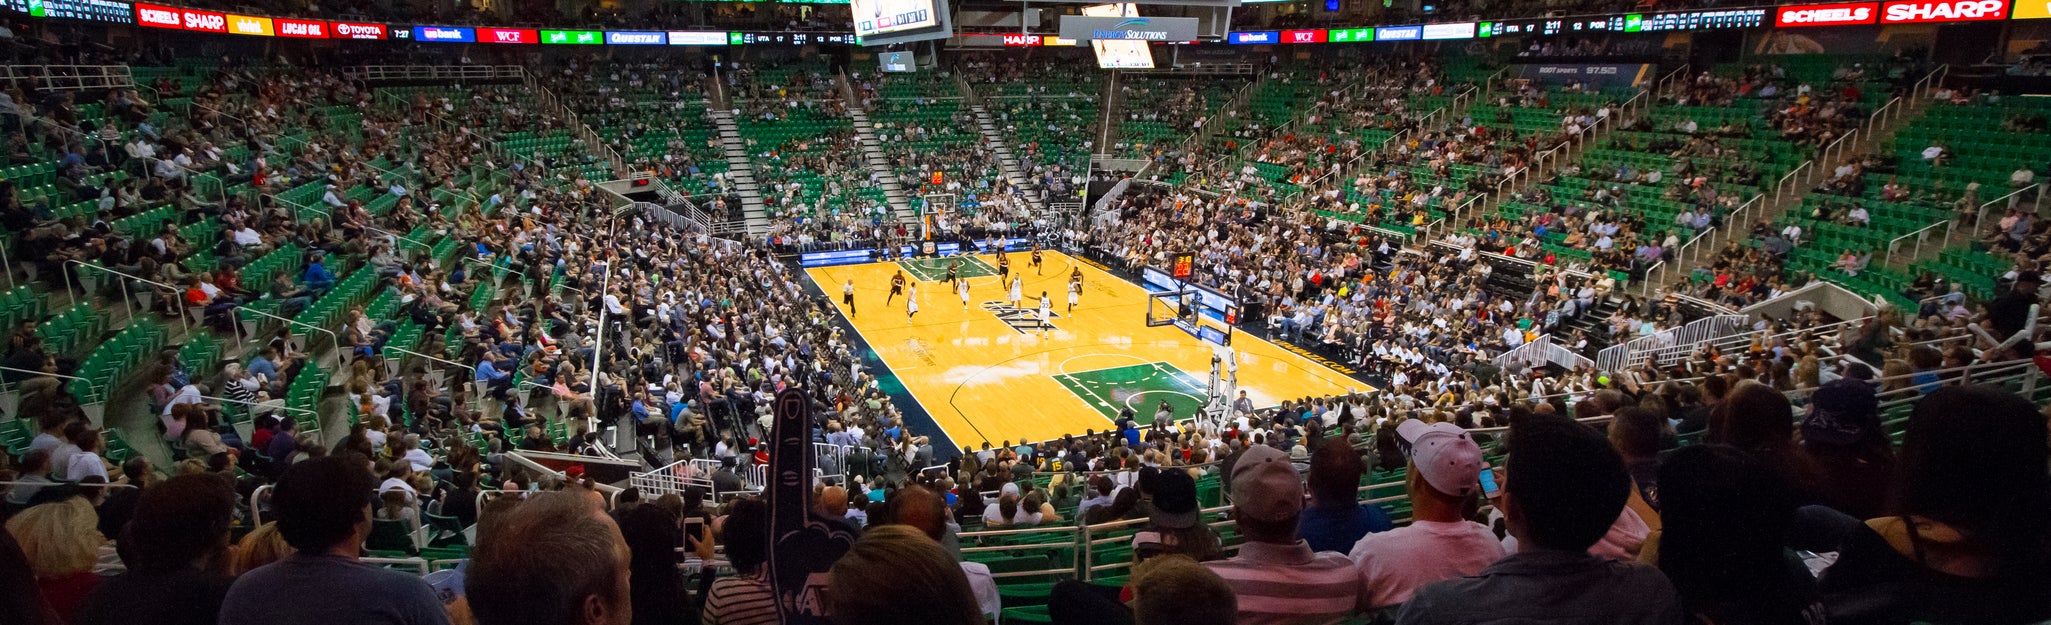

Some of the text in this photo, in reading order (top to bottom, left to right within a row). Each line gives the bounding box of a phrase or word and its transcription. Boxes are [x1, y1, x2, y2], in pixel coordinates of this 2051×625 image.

[1782, 8, 1871, 23] SCHEELS
[1886, 0, 2002, 21] SHARP
[140, 9, 180, 25] SCHEELS
[184, 12, 224, 30] SHARP
[282, 23, 322, 35] LUCAS OIL
[1526, 24, 1535, 32] 17
[1545, 20, 1562, 29] 3:11
[1573, 22, 1583, 30] 12
[1589, 21, 1606, 29] POR
[350, 26, 381, 35] TOYOTA
[496, 31, 520, 42] WCF
[1295, 32, 1313, 41] WCF
[1052, 461, 1062, 471] 15
